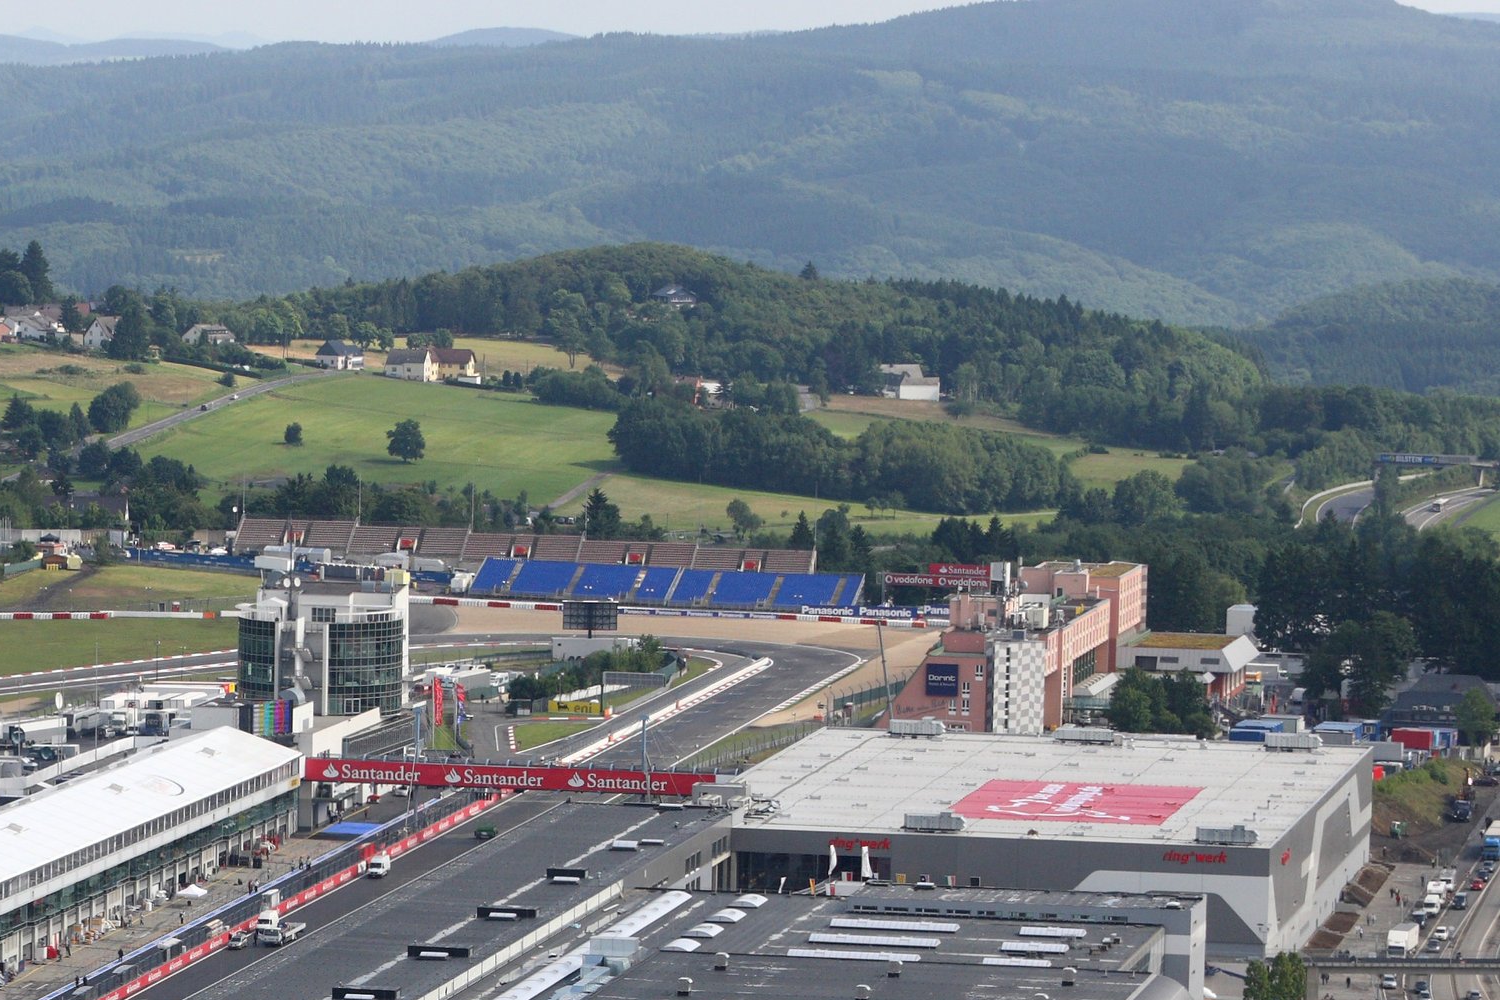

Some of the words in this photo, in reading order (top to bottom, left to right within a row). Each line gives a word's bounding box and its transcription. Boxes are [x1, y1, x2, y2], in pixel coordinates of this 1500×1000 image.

[948, 565, 987, 575] Santander
[894, 576, 933, 585] vodafone
[801, 605, 854, 616] Panasonic
[859, 607, 912, 618] Panasonic
[928, 674, 956, 682] Dorint
[574, 703, 593, 713] eni
[341, 764, 421, 782] Santander
[463, 769, 544, 787] Santander
[586, 773, 667, 792] Santander
